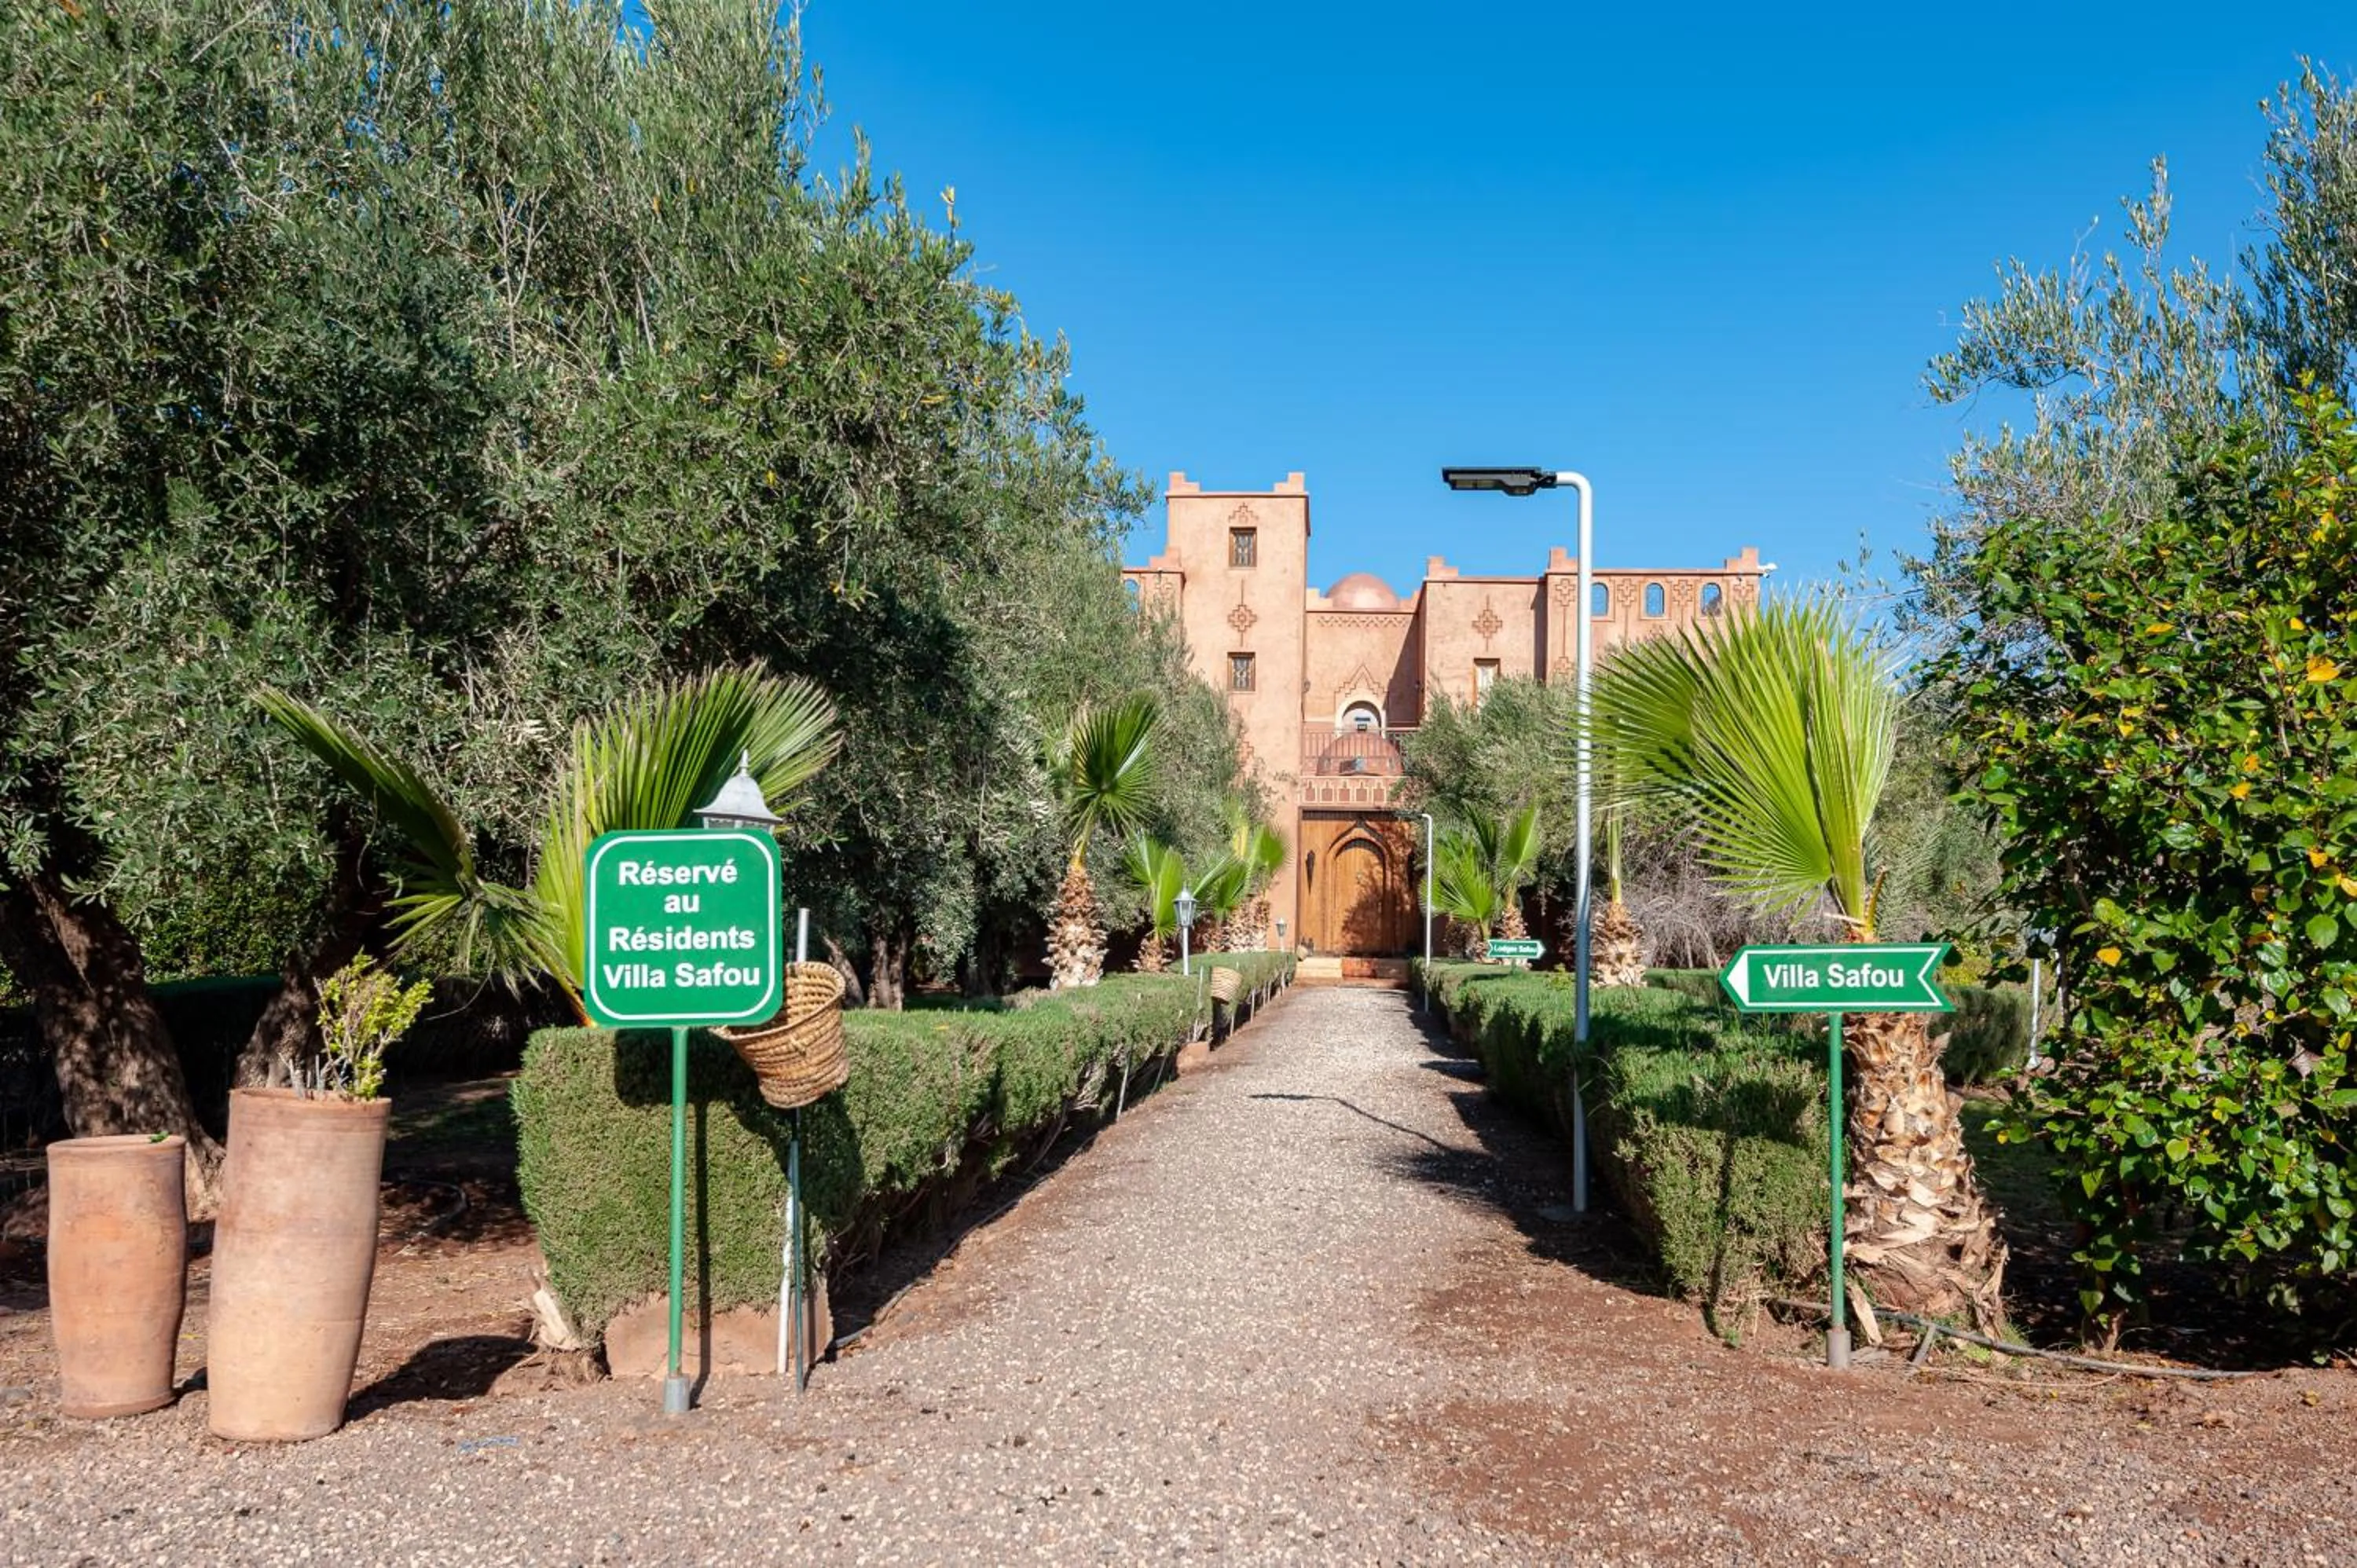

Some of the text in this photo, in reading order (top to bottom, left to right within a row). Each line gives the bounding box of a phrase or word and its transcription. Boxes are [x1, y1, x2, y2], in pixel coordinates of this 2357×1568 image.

[618, 858, 738, 885] Réservé
[664, 894, 700, 913] au
[608, 925, 756, 951] Résidents
[603, 962, 761, 988] Villa Safou
[1763, 962, 1904, 988] Villa Safou
